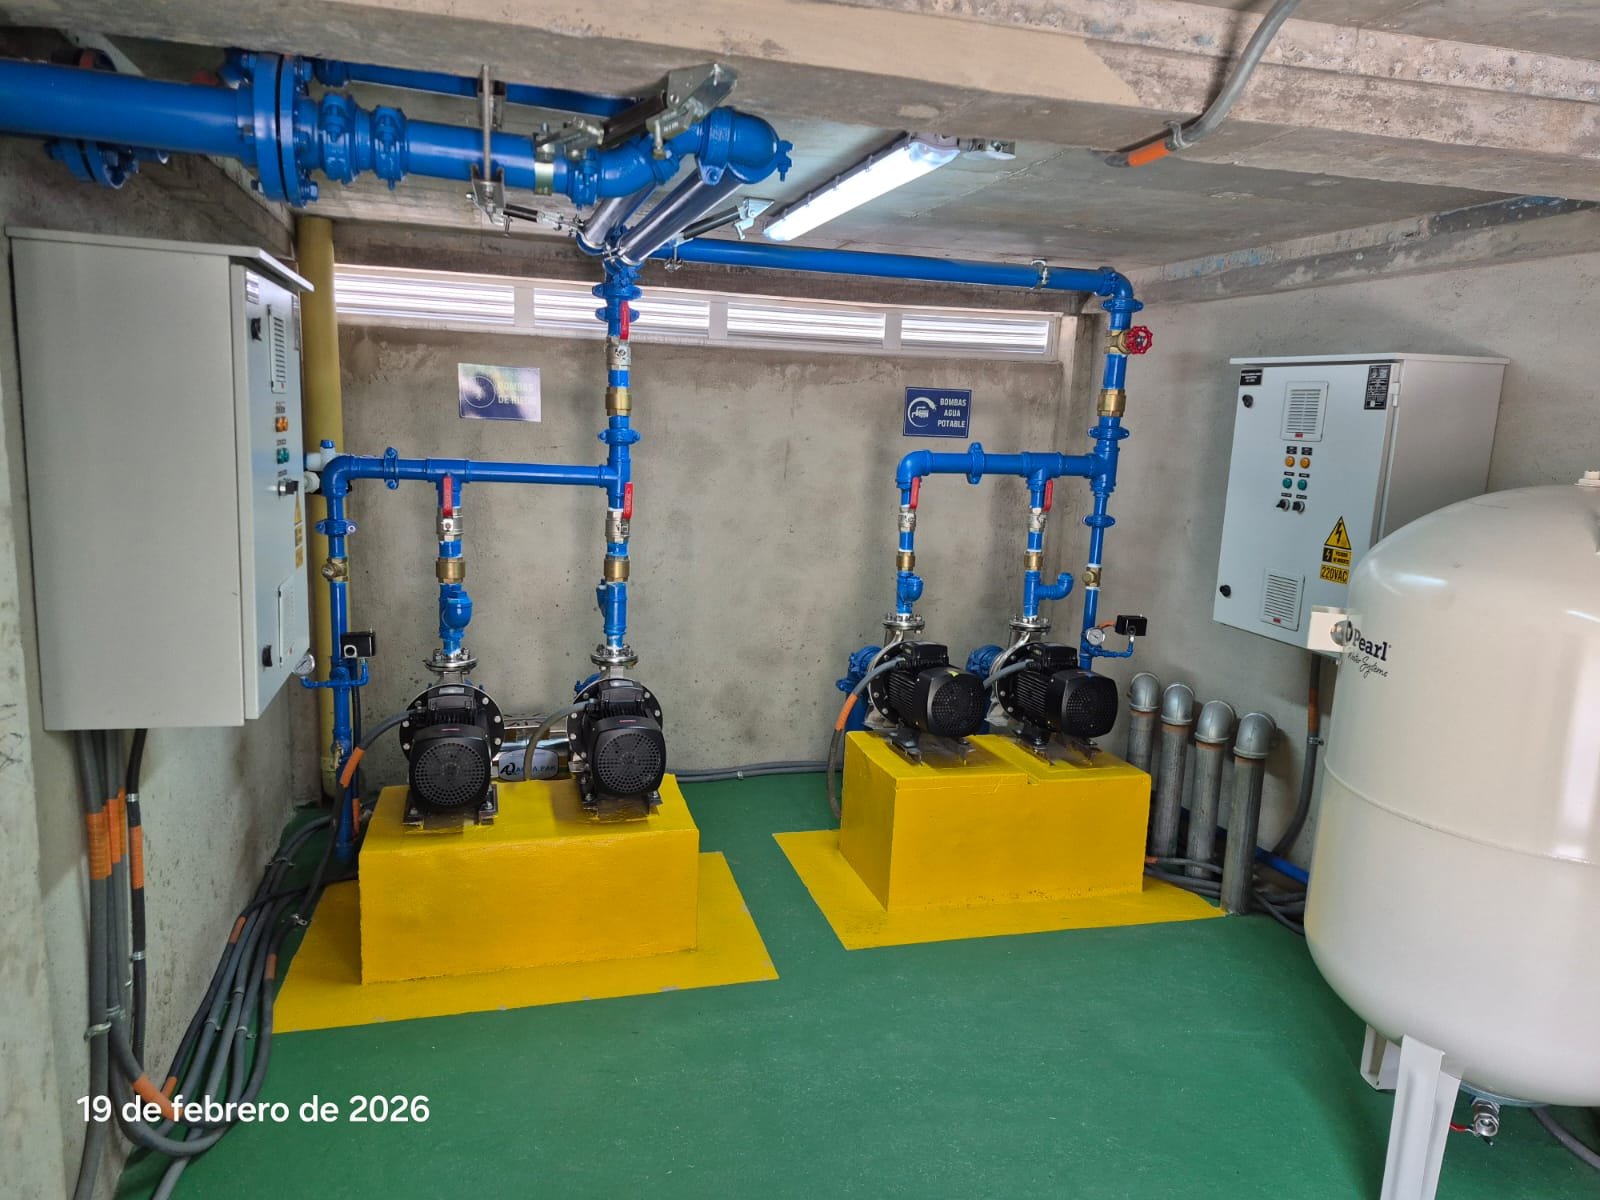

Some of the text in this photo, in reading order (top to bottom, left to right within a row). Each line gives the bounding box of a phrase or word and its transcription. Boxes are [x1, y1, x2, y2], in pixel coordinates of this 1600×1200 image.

[940, 398, 967, 407] BOMBAS
[943, 409, 961, 417] AGUA
[937, 419, 966, 428] POTABLE
[1321, 566, 1348, 582] 220VAC
